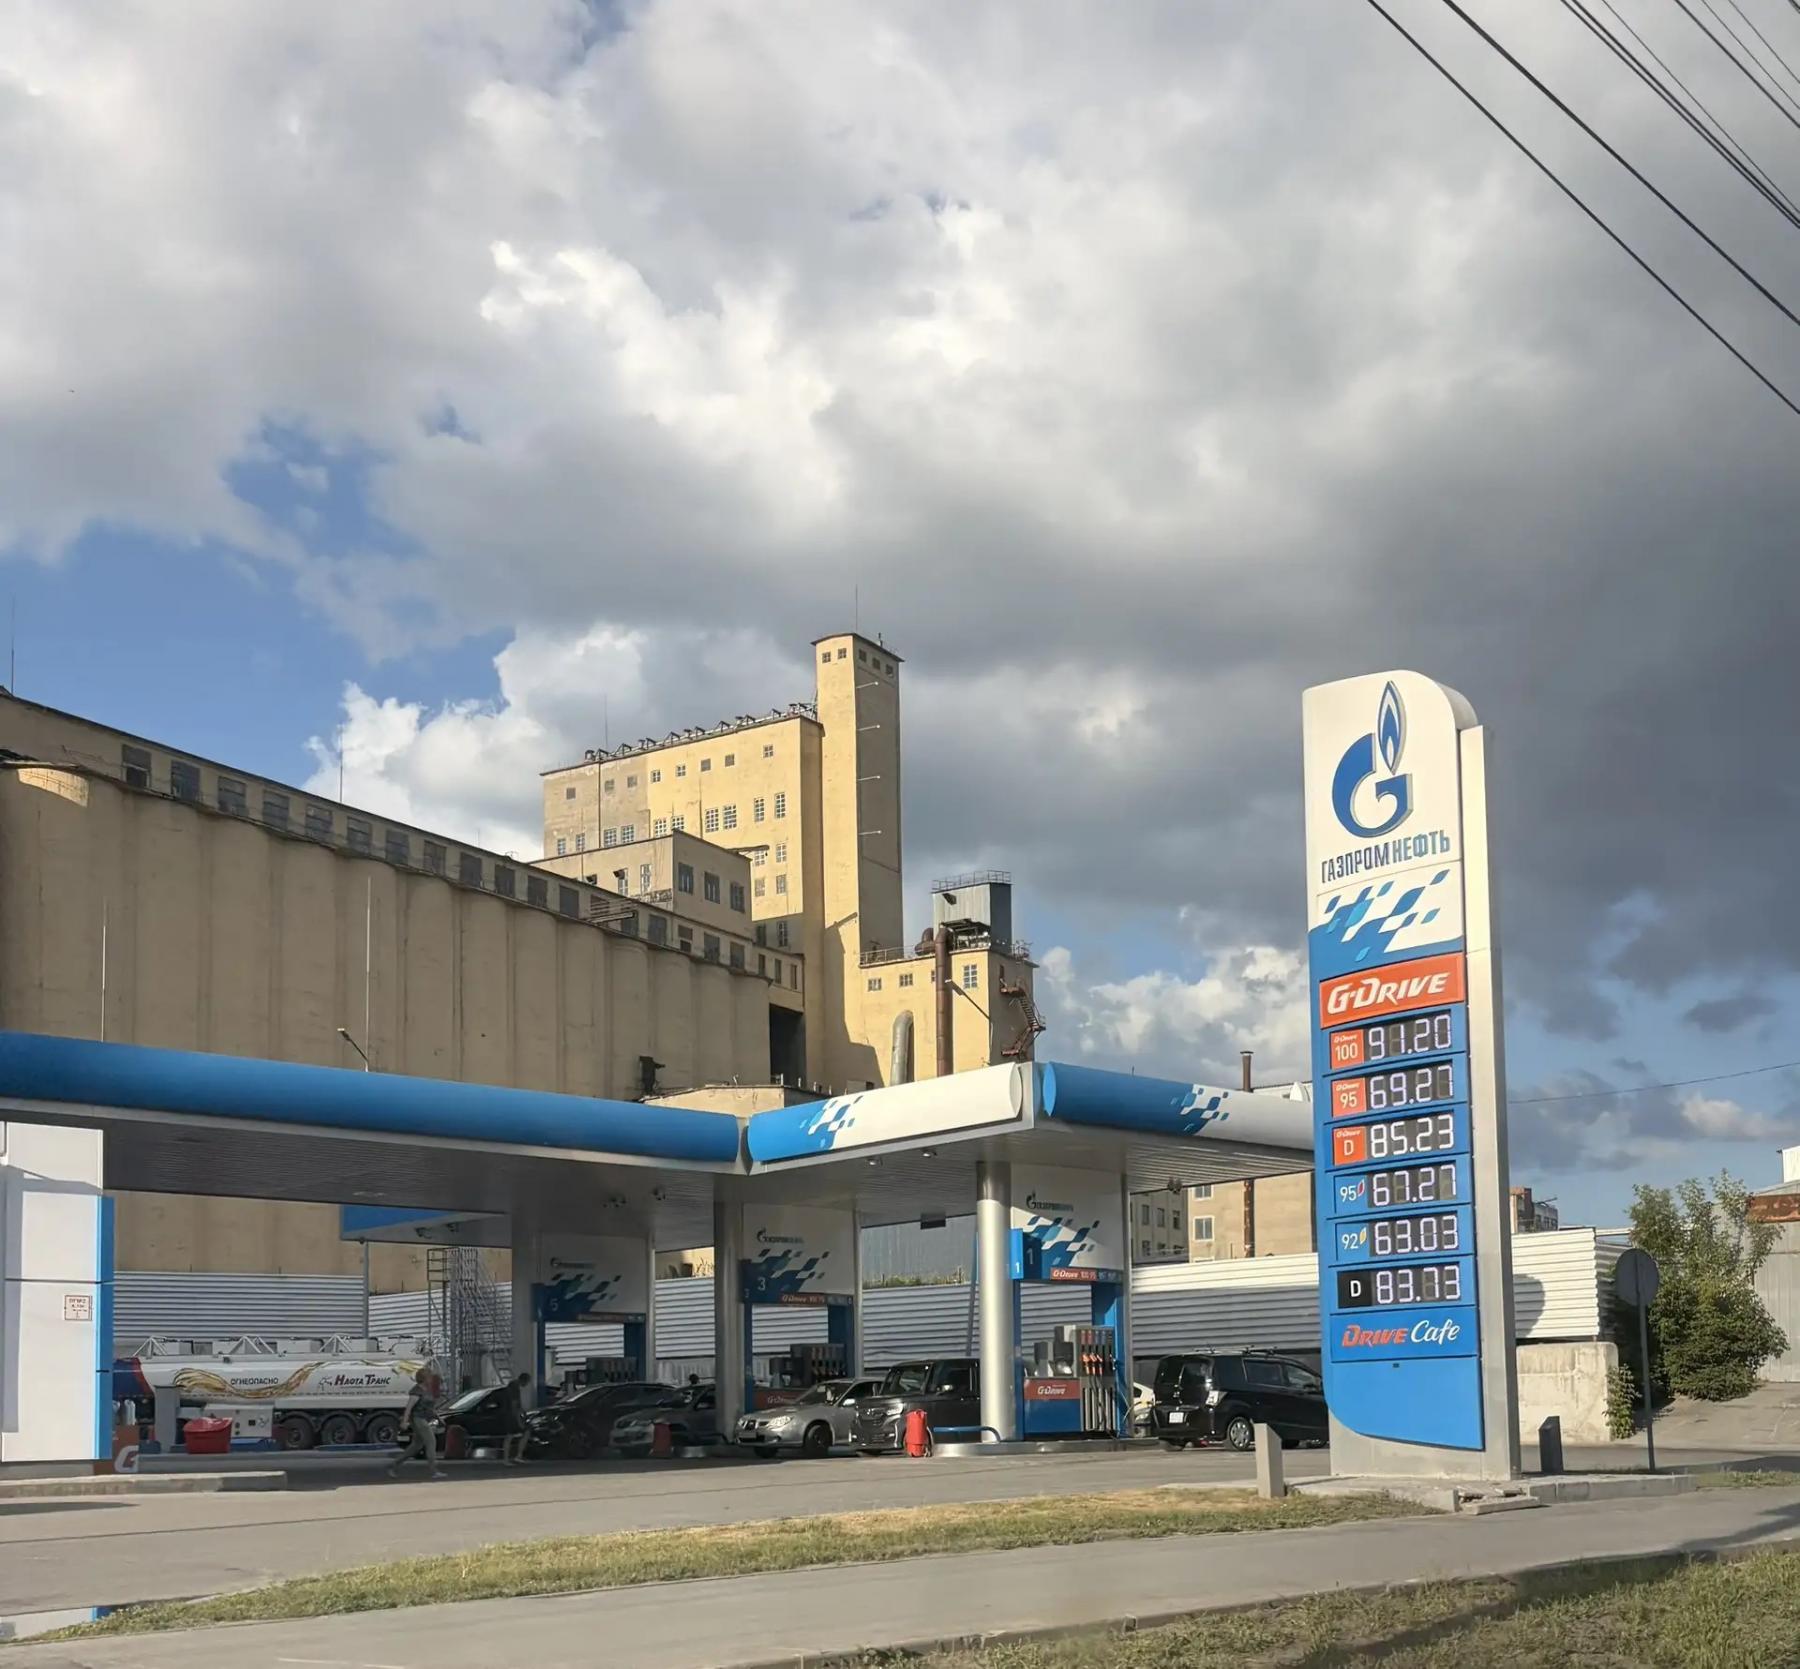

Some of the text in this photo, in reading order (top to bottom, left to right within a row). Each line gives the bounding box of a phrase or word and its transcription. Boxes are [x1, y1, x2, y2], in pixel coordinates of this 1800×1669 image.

[1321, 829, 1451, 884] ГАЗПРОМНЕФТЬ
[1335, 1042, 1359, 1062] 100
[1368, 1014, 1451, 1061] 91.20
[1340, 1092, 1358, 1109] 95
[1370, 1065, 1454, 1109] 69.27
[1343, 1139, 1355, 1157] D
[1371, 1114, 1455, 1158] 85.23
[1339, 1164, 1457, 1207] 95 67.27
[1341, 1215, 1459, 1255] 92 63.03
[1015, 1261, 1020, 1273] 1
[1026, 1247, 1034, 1265] 1
[757, 1276, 766, 1291] 3
[1350, 1265, 1461, 1305] D 83.73
[1341, 1318, 1461, 1348] DRIVE Cafe
